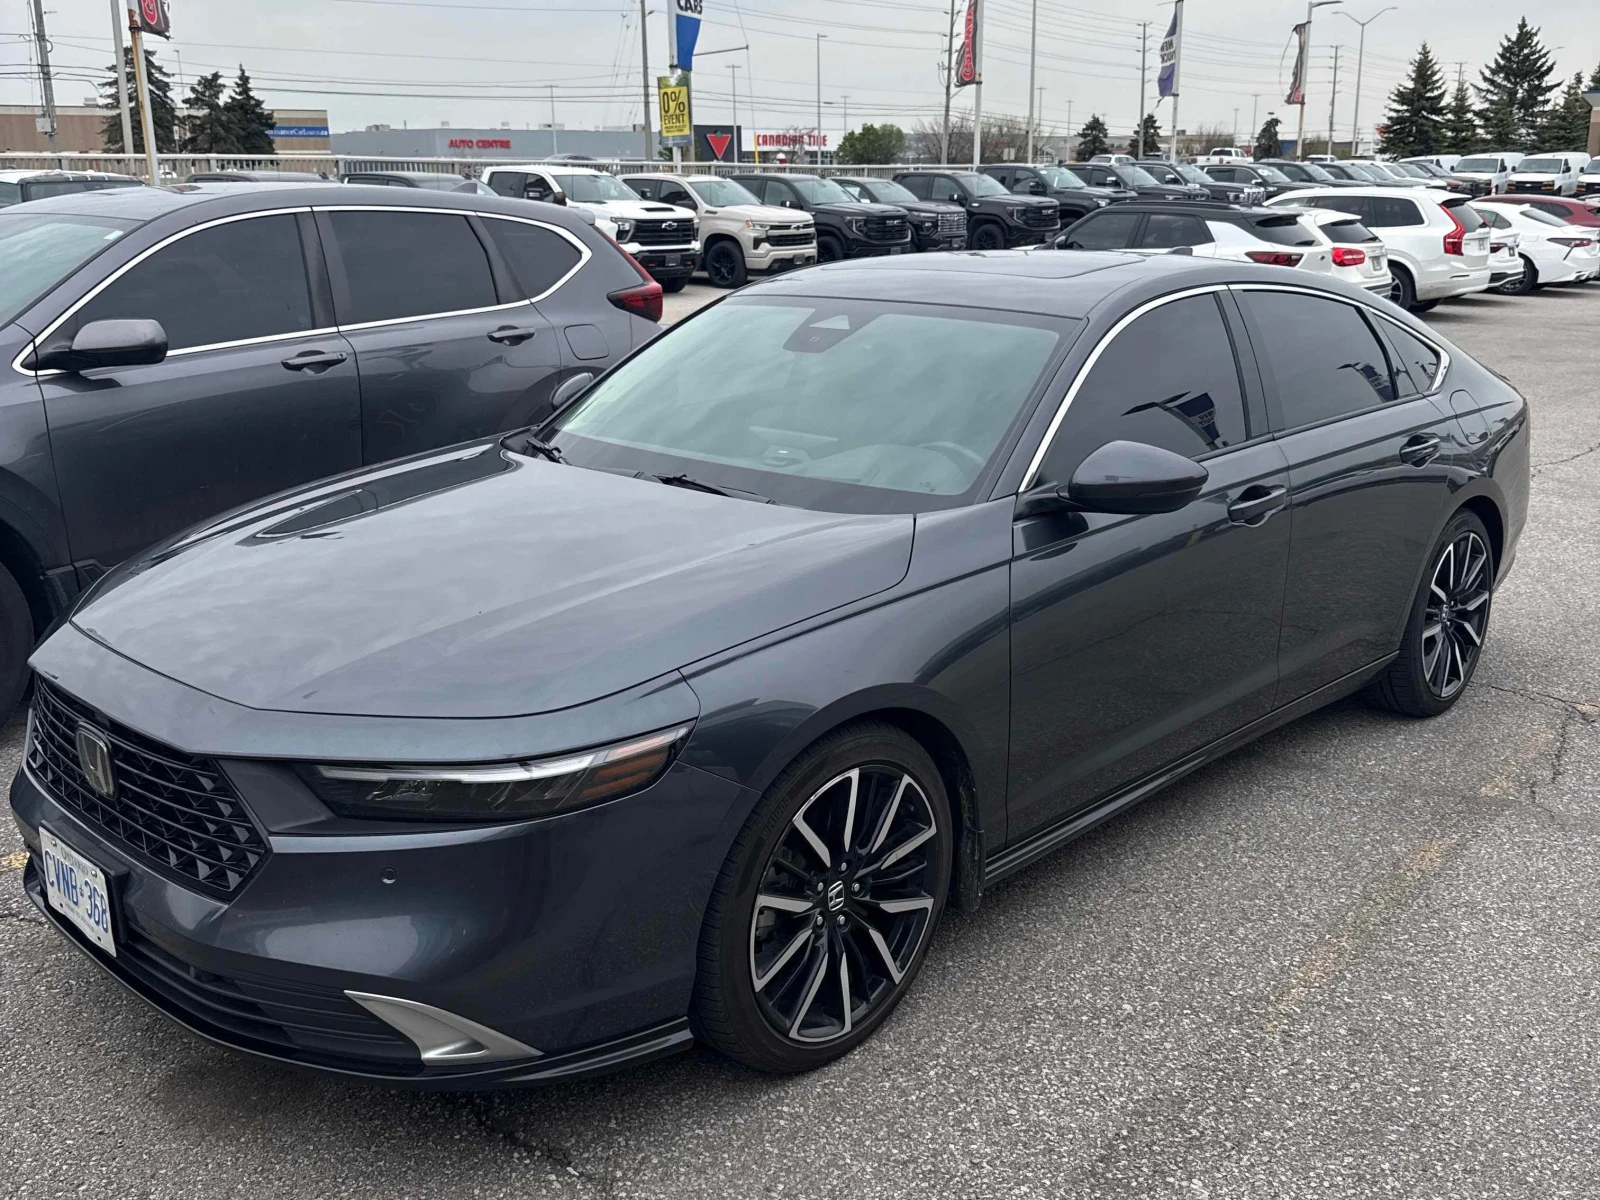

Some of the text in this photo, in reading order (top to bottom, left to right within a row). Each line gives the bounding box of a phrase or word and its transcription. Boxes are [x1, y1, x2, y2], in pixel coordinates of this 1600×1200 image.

[676, 0, 703, 15] CARS
[662, 90, 686, 114] 0%
[663, 113, 685, 125] EVENT
[448, 138, 512, 149] AUTO CENTRE
[756, 134, 804, 147] CANADIAN
[44, 849, 79, 906] CVNB
[84, 879, 109, 934] 368
